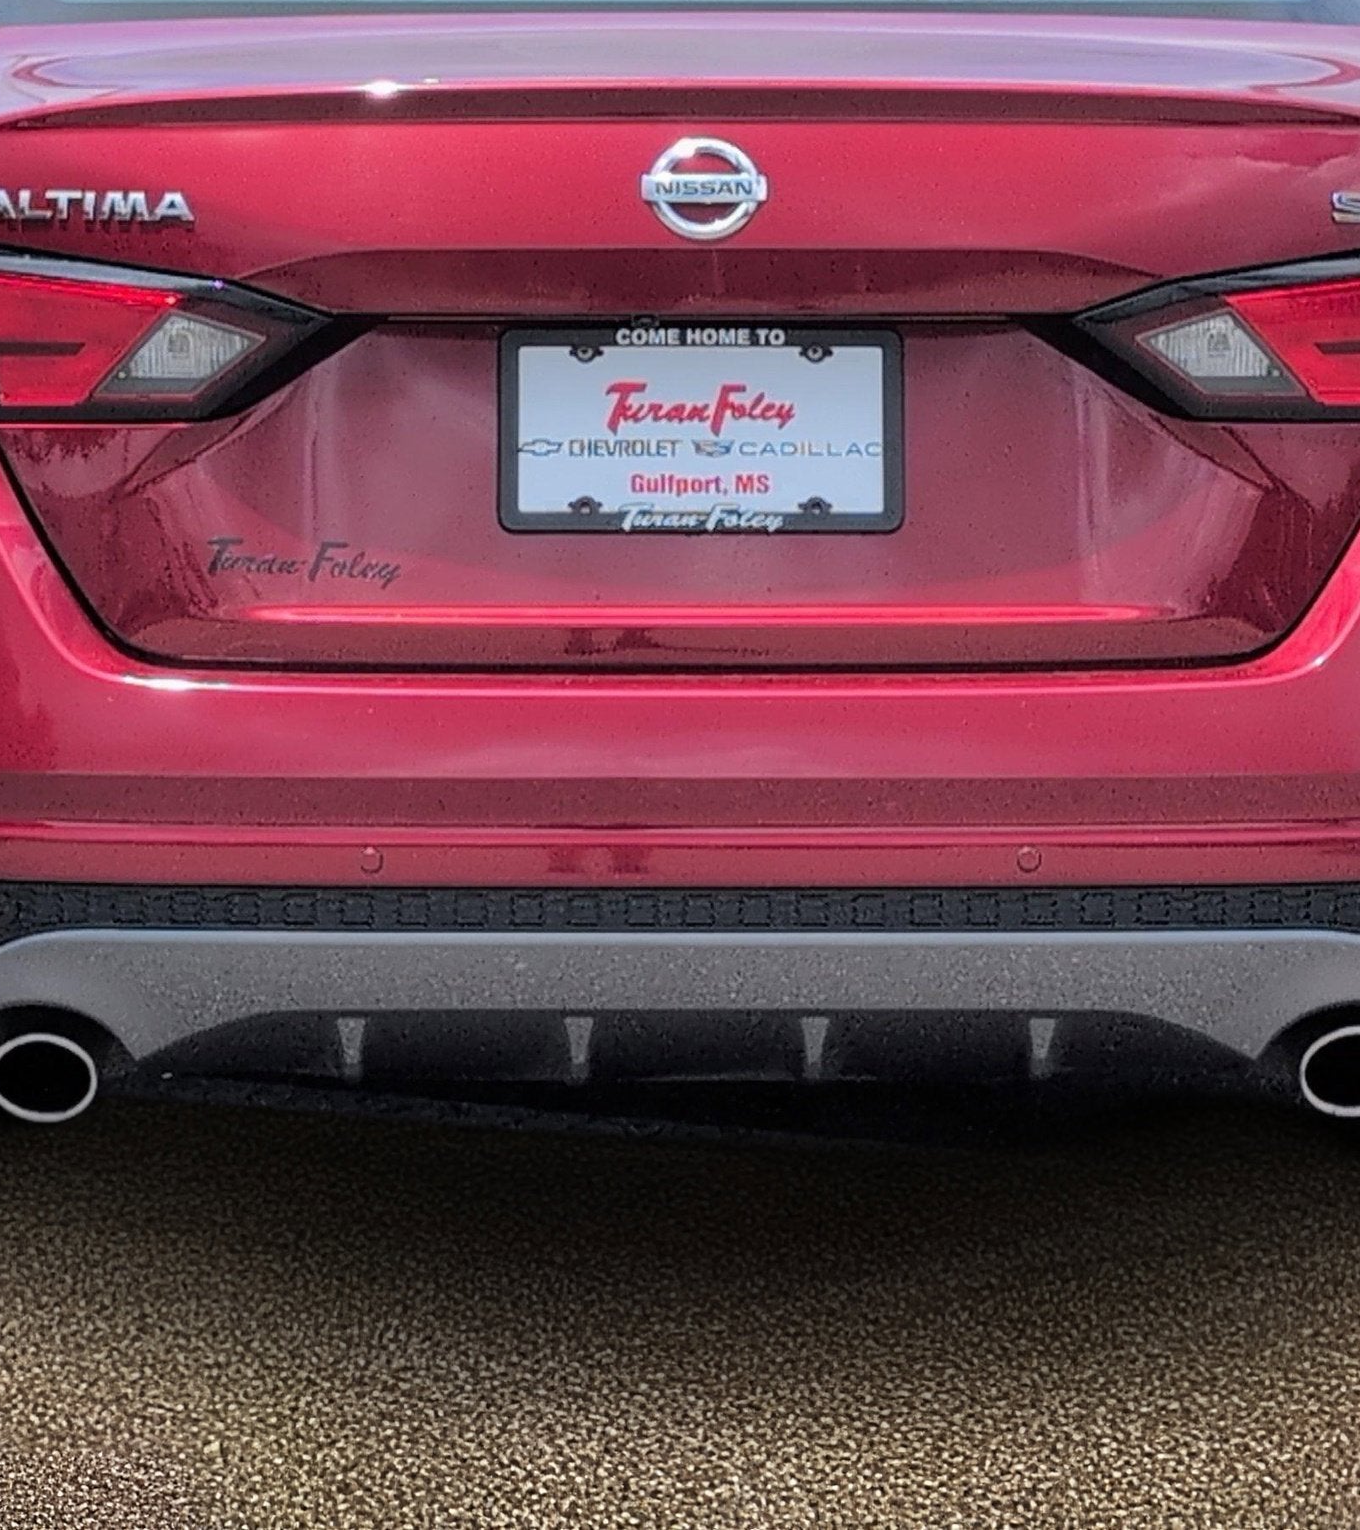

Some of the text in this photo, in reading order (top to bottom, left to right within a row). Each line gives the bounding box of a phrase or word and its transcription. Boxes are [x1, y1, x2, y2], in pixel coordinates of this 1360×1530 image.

[656, 181, 752, 195] NISSAN
[616, 328, 786, 345] COME HOME TO
[568, 439, 882, 458] CHEVROLET CADILLAC
[631, 474, 770, 496] Gulfport, MS
